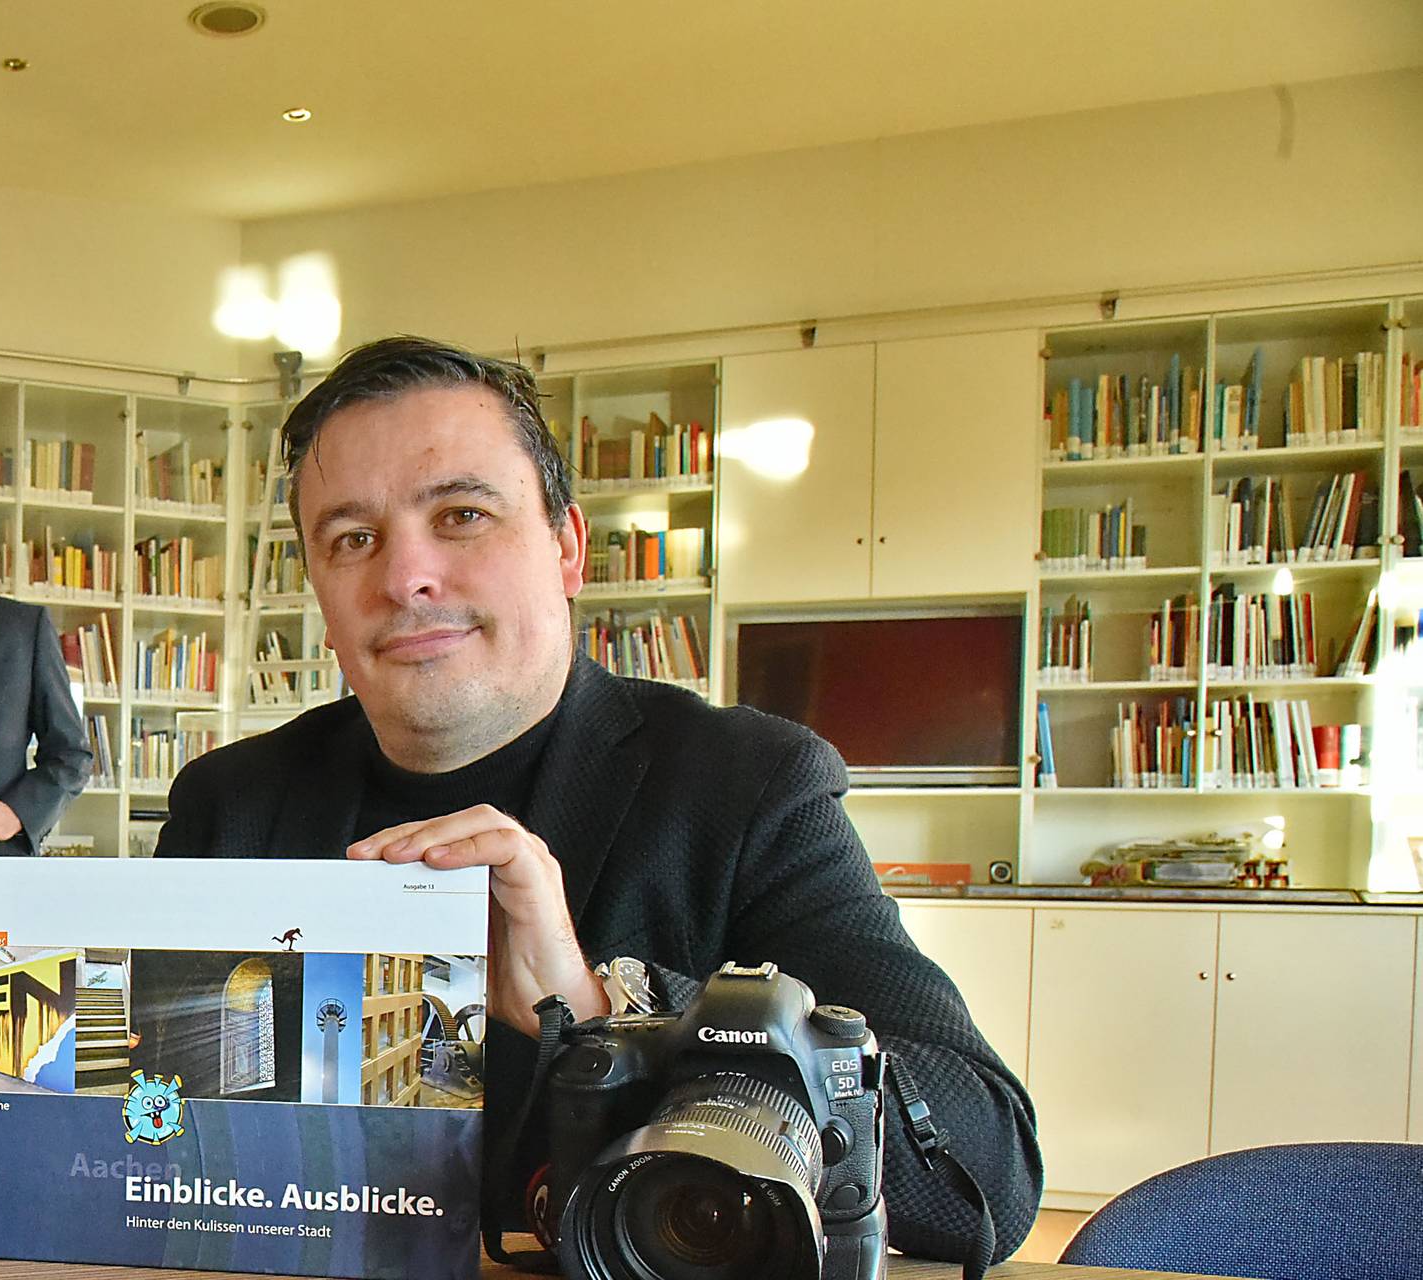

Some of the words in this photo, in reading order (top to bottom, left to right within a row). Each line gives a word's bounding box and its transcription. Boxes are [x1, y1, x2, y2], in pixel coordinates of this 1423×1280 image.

[697, 1026, 768, 1044] Canon
[832, 1060, 858, 1072] EOS
[838, 1077, 855, 1090] 5D
[835, 1090, 853, 1098] Mark
[70, 1152, 182, 1181] Aachen
[608, 1168, 630, 1192] CANON
[629, 1154, 653, 1170] ZOOM
[125, 1176, 273, 1208] Einblicke.
[280, 1183, 444, 1217] Ausblicke.
[126, 1215, 165, 1229] Hinter
[167, 1218, 191, 1230] den
[194, 1219, 245, 1233] Kulissen
[247, 1224, 295, 1236] unserer
[298, 1224, 332, 1238] Stadt
